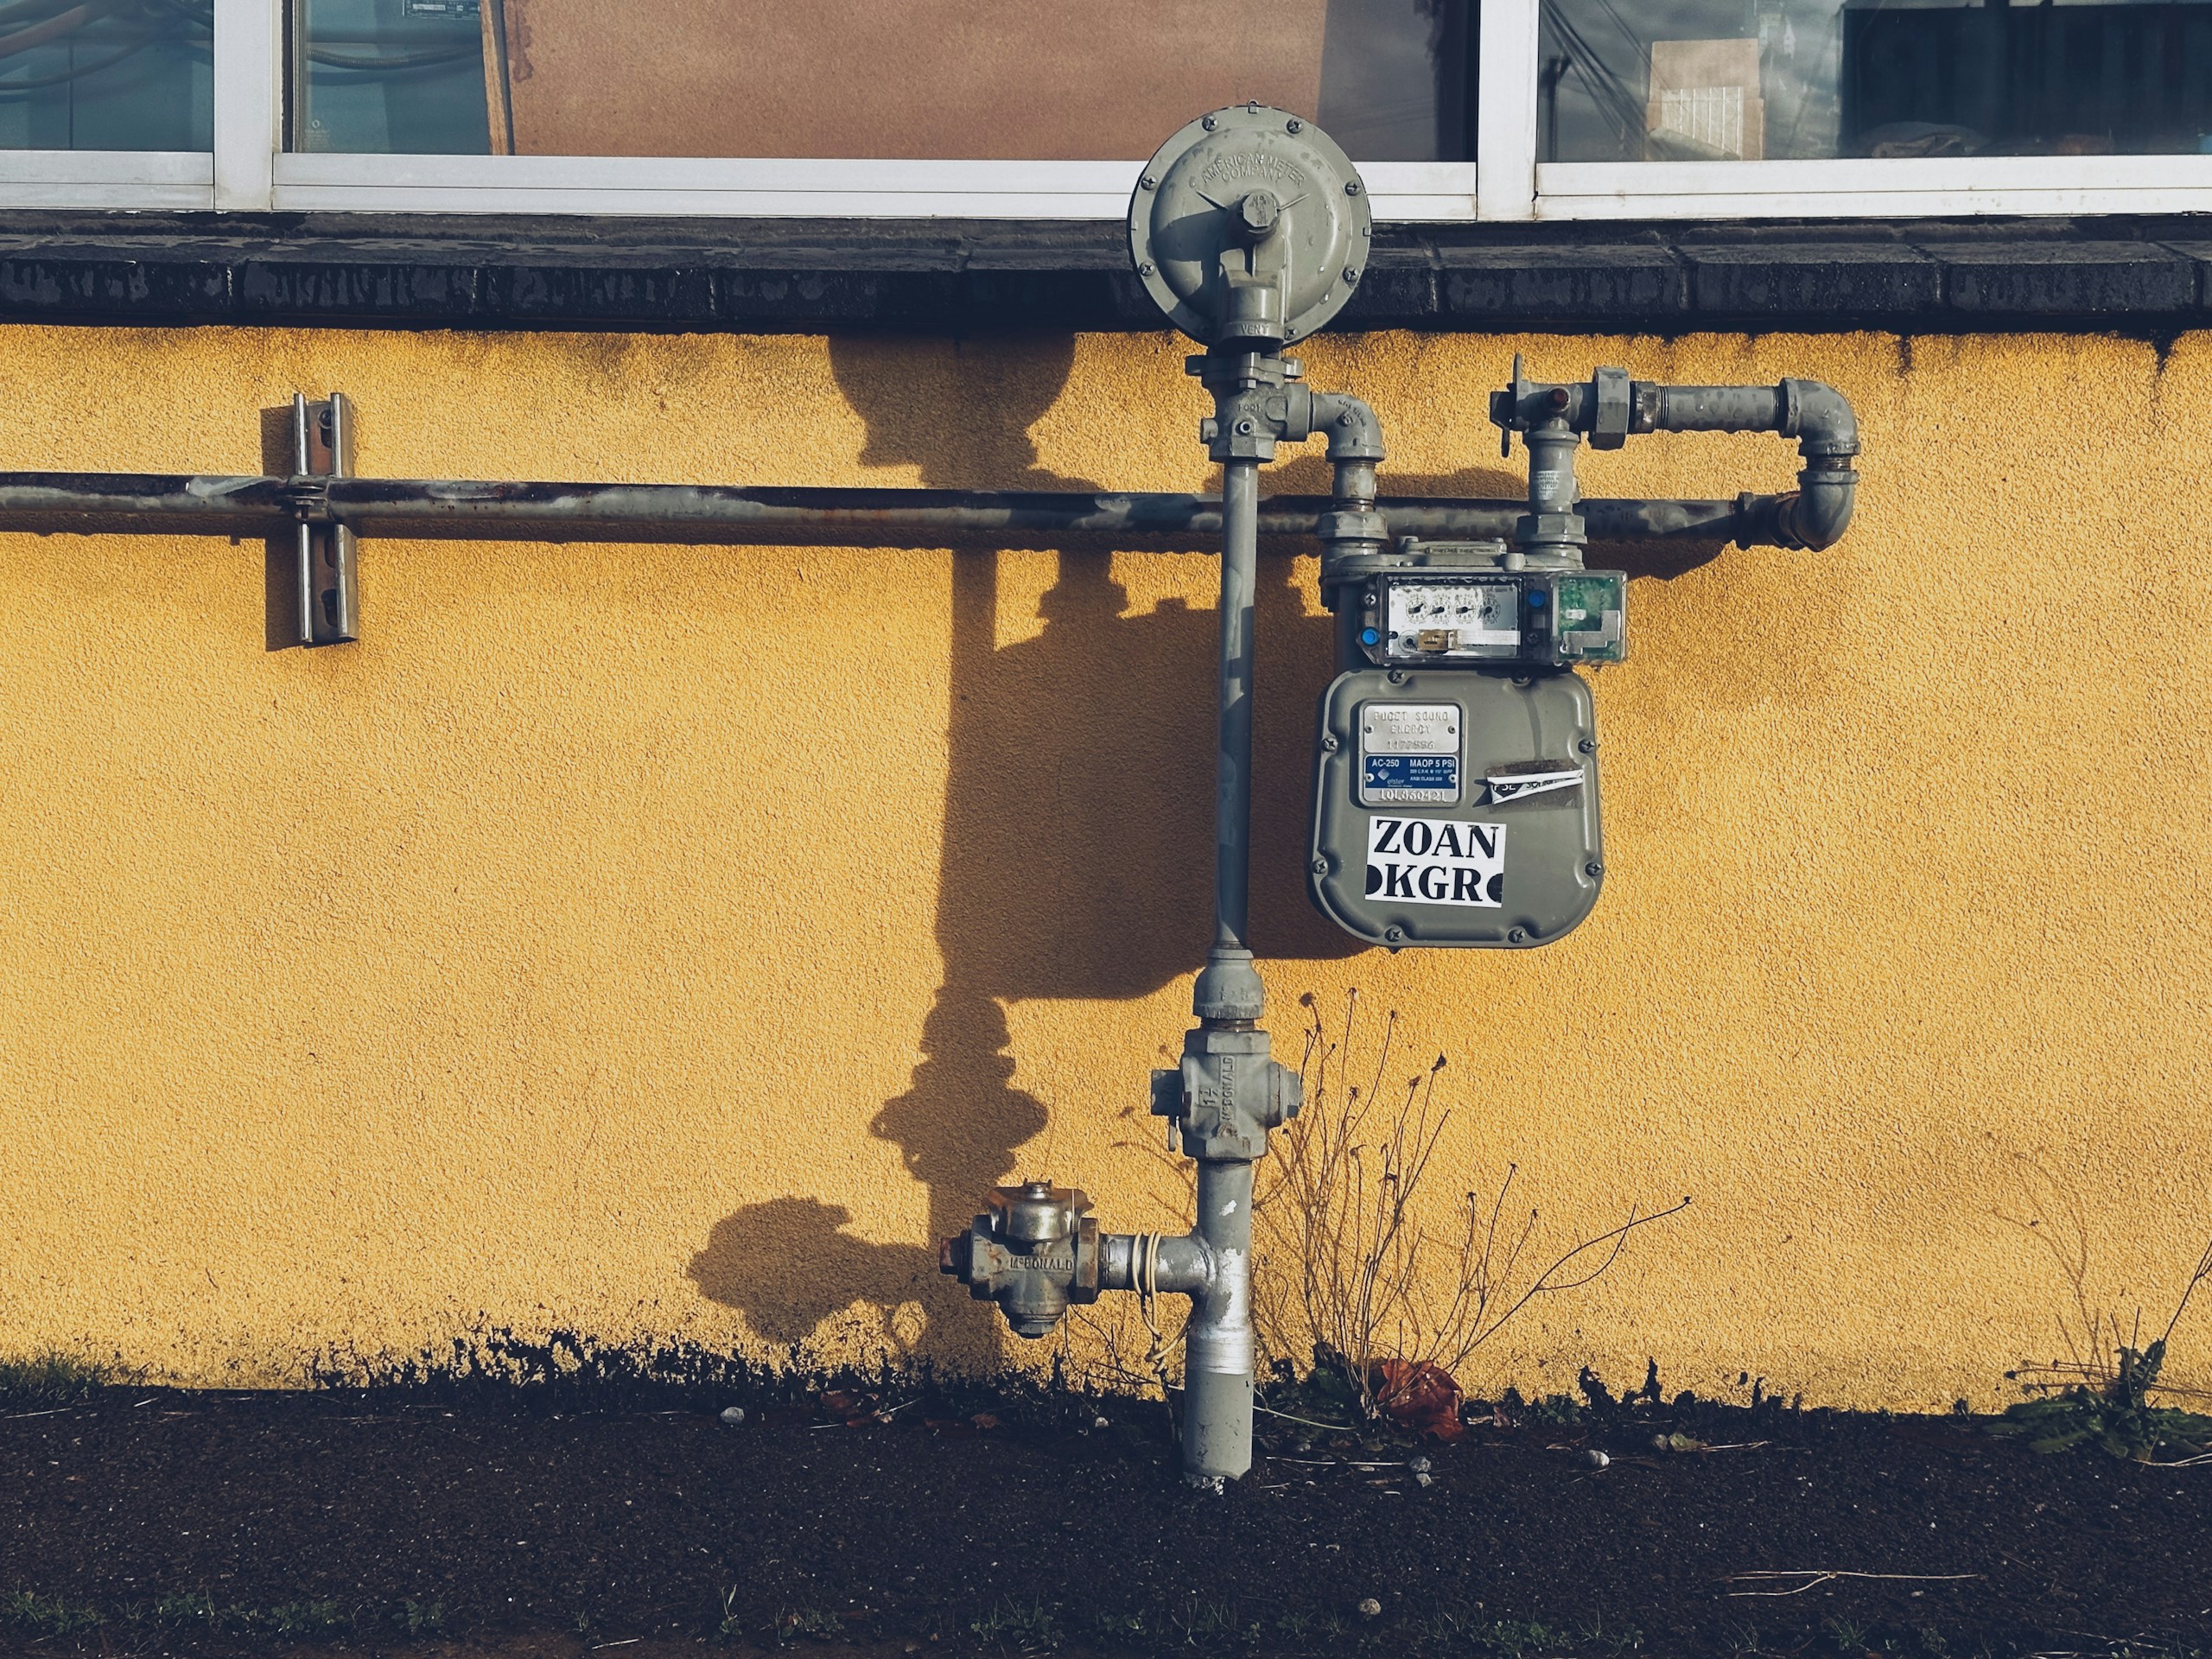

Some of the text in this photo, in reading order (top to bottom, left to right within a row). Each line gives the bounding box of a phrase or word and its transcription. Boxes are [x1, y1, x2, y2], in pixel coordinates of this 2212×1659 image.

[1201, 153, 1306, 188] AMERICAN METER
[1220, 164, 1282, 183] COMPANY
[1241, 323, 1271, 336] VENT
[1374, 711, 1449, 721] PUGET SOUND
[1390, 724, 1431, 734] ENERGY
[1371, 759, 1400, 767] AC-250
[1409, 759, 1455, 767] MAOP 5 PSI
[1374, 819, 1499, 859] ZOAN
[1383, 863, 1483, 902] KGR
